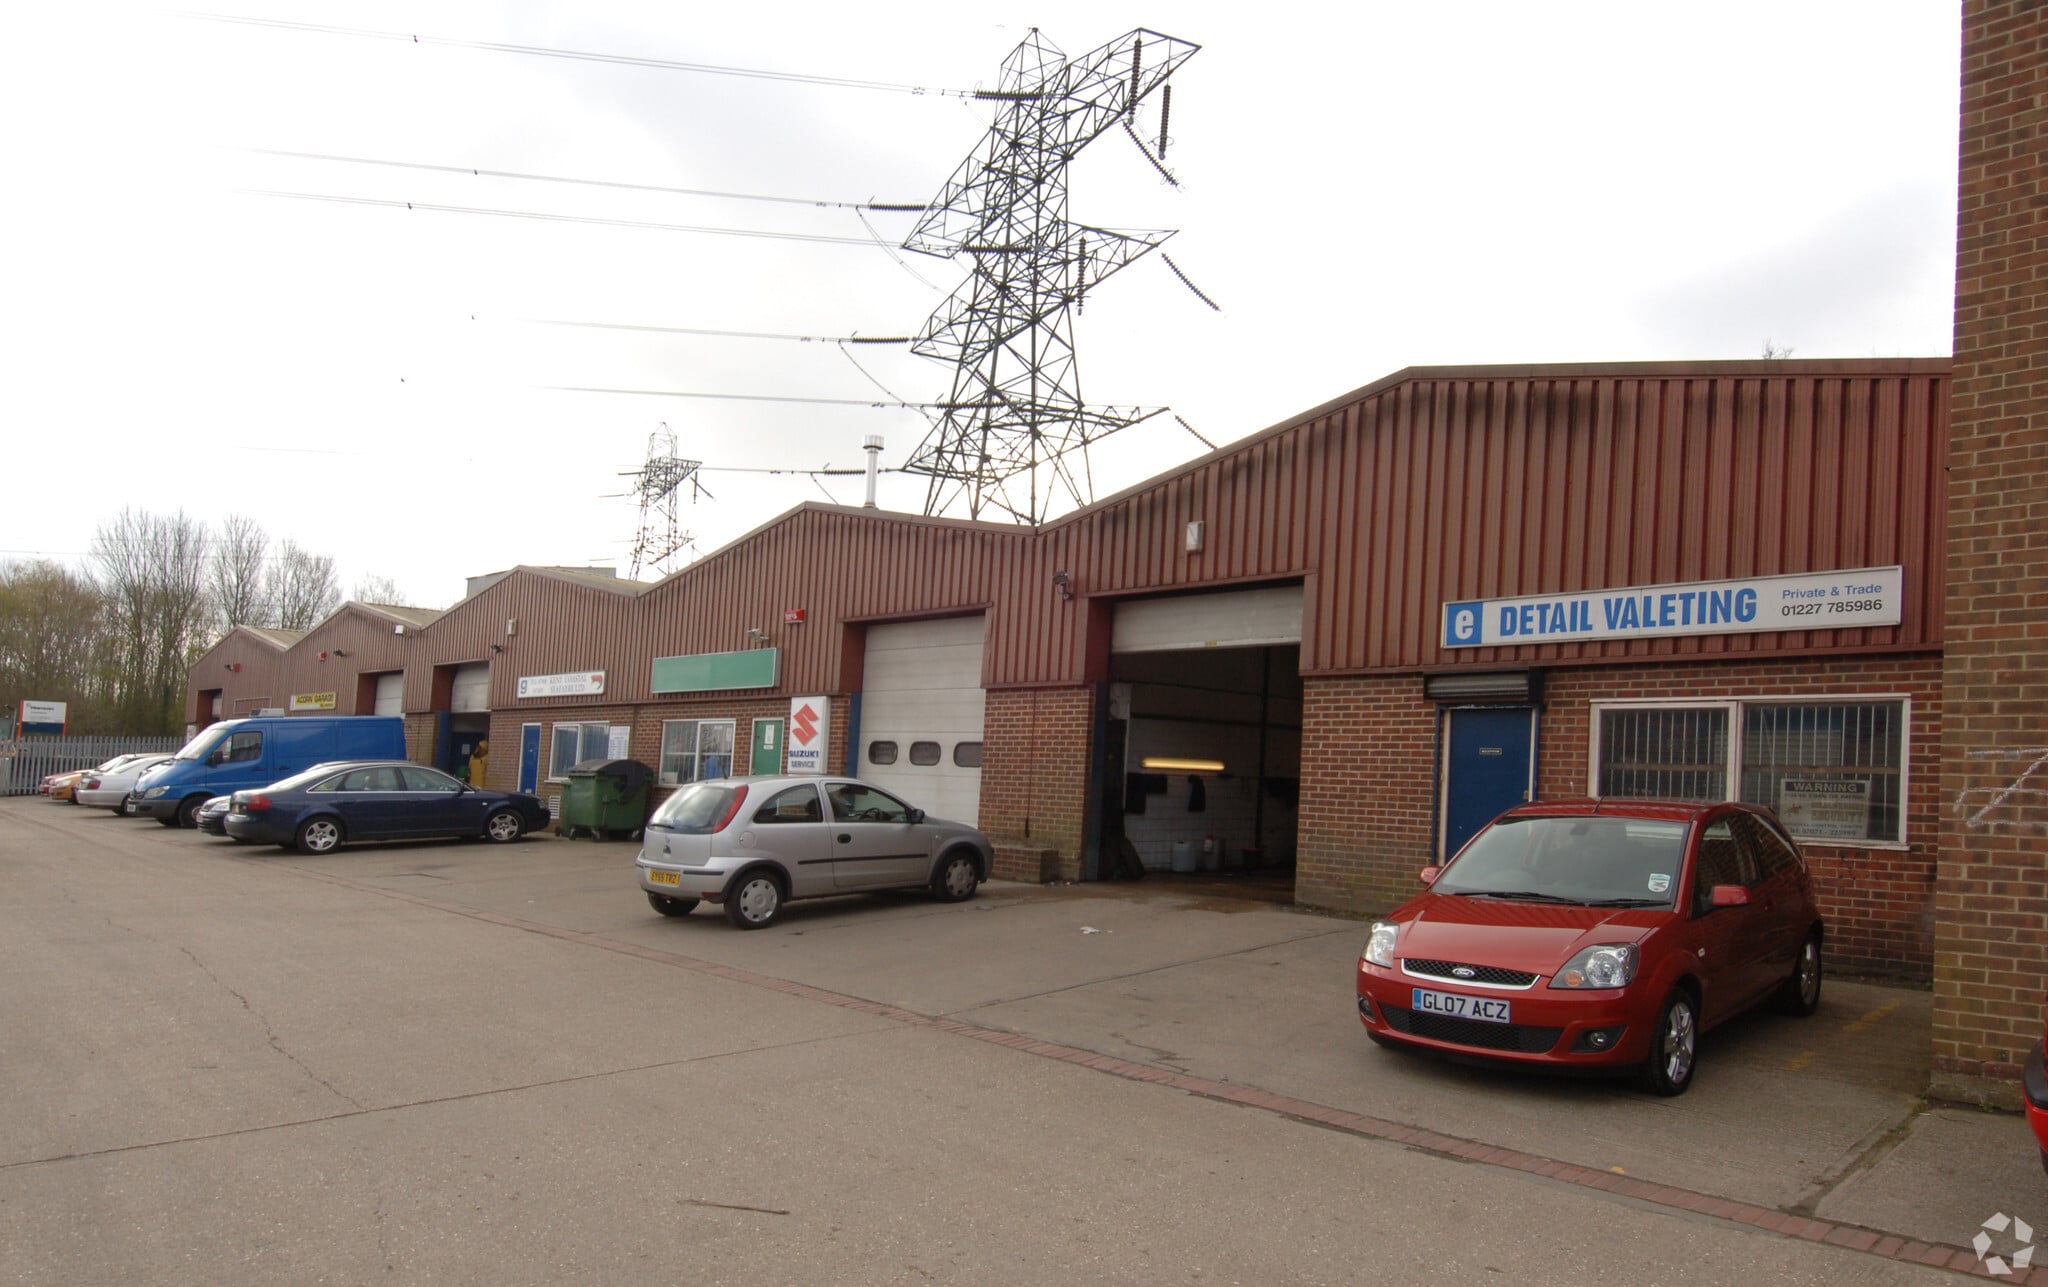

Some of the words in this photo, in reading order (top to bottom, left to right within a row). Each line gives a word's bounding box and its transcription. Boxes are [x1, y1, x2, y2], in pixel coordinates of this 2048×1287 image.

[1782, 586, 1826, 600] Private
[1831, 586, 1840, 597] &
[1845, 583, 1883, 595] Trade
[1500, 599, 1593, 637] DETAIL
[1603, 587, 1757, 631] VALETING
[1782, 602, 1823, 617] 01227
[1827, 598, 1883, 614] 785986
[1455, 610, 1473, 640] e
[520, 679, 528, 694] g
[549, 676, 562, 685] KENT
[296, 695, 313, 704] ACORN
[314, 693, 334, 703] GARAGE
[791, 760, 815, 768] SERVICE
[1793, 782, 1857, 792] WARNING
[1423, 993, 1466, 1014] GL07
[1472, 1000, 1508, 1020] ACZ
